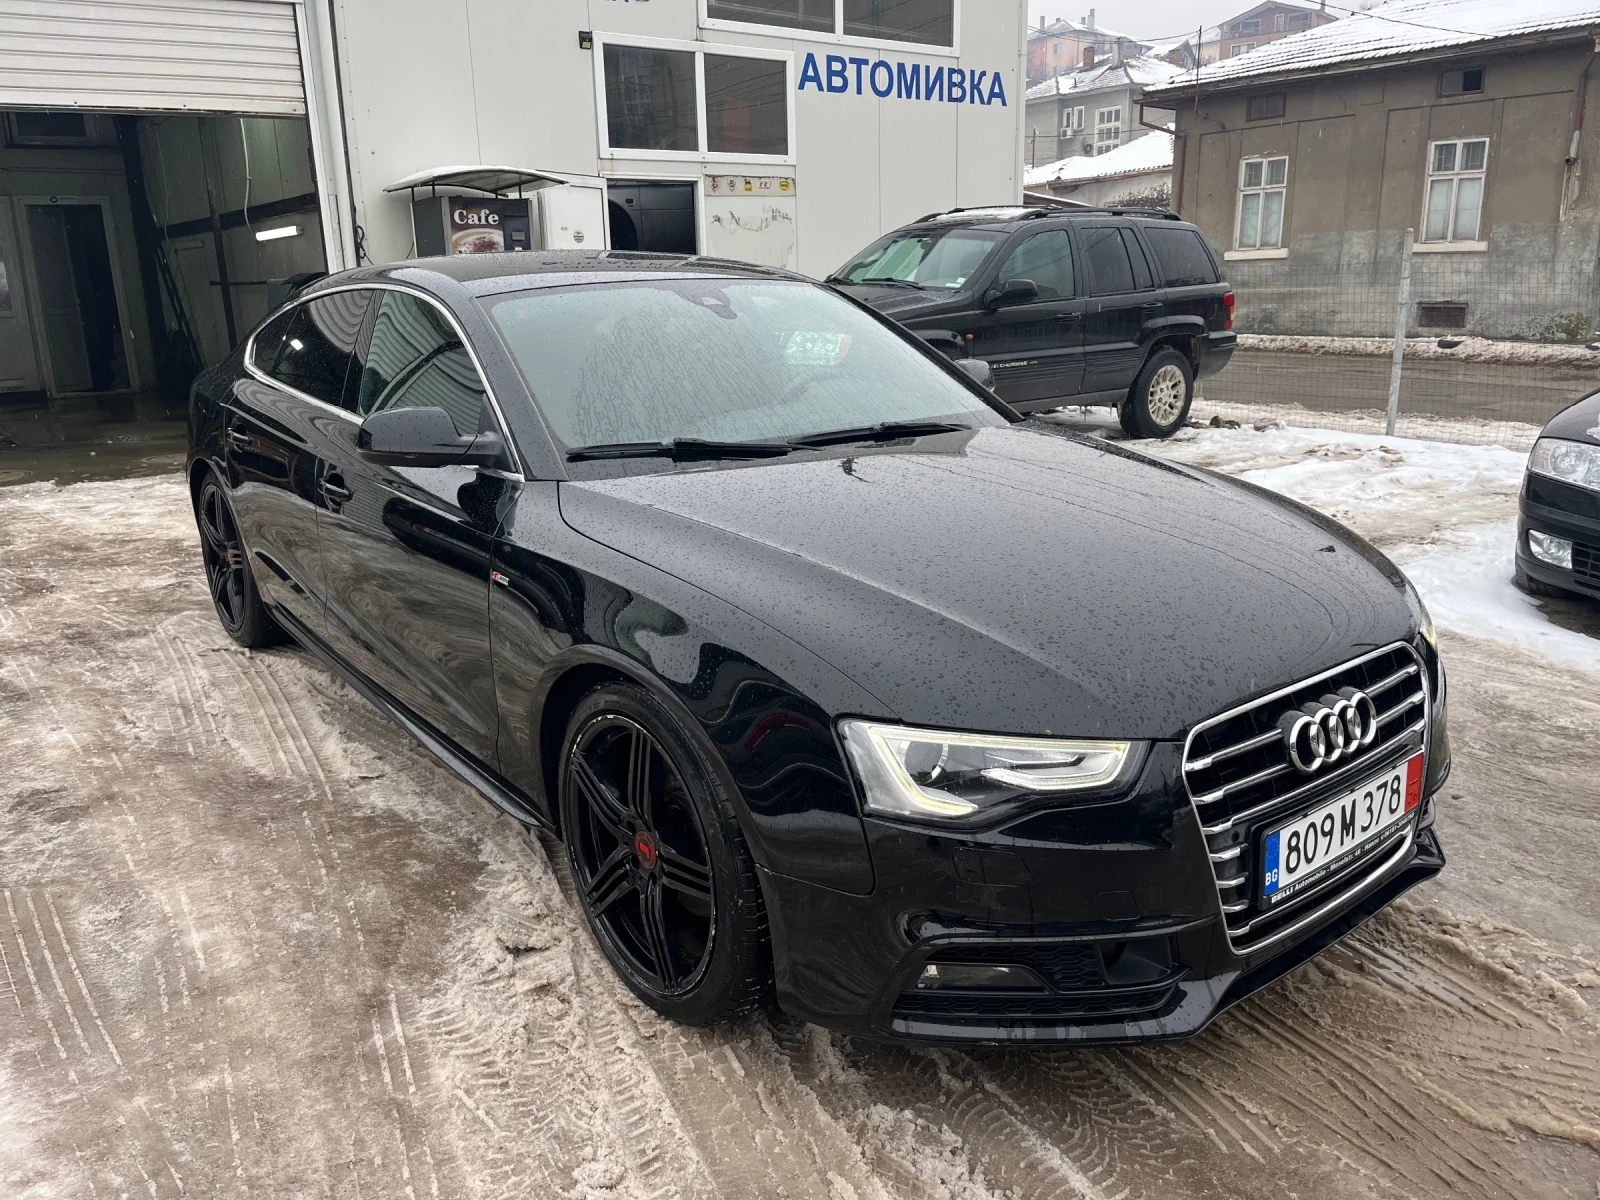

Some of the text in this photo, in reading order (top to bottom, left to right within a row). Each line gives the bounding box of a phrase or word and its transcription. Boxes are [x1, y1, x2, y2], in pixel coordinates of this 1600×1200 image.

[798, 52, 1008, 107] АВТОМИВКА
[453, 208, 500, 225] Cafe
[1265, 868, 1278, 887] BG
